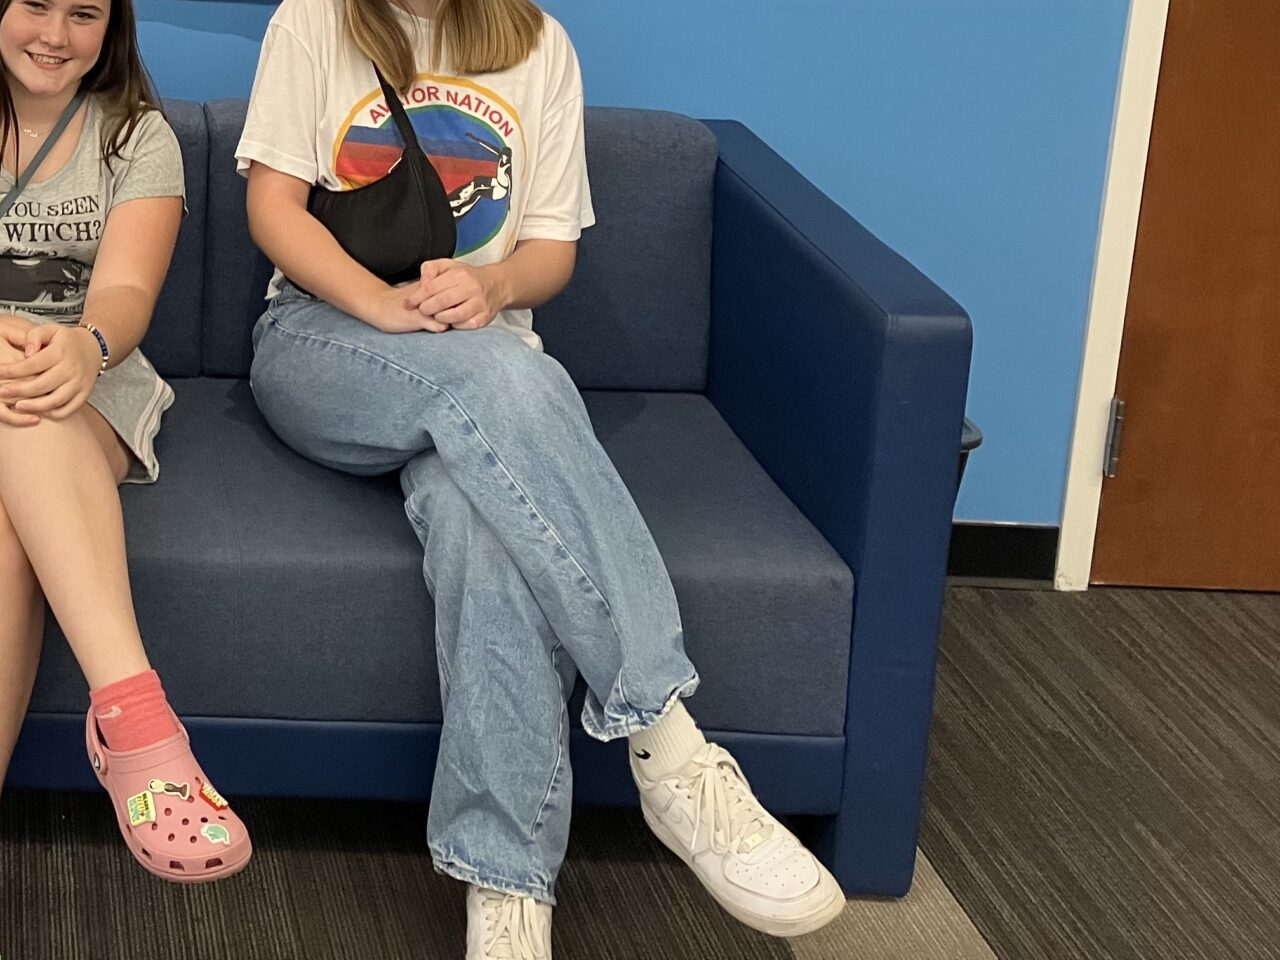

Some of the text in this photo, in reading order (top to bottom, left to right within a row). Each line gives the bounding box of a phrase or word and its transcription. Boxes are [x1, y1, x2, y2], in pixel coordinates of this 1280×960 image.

[445, 89, 514, 138] NATION
[46, 195, 100, 217] SEEN
[3, 219, 102, 243] WITCH?
